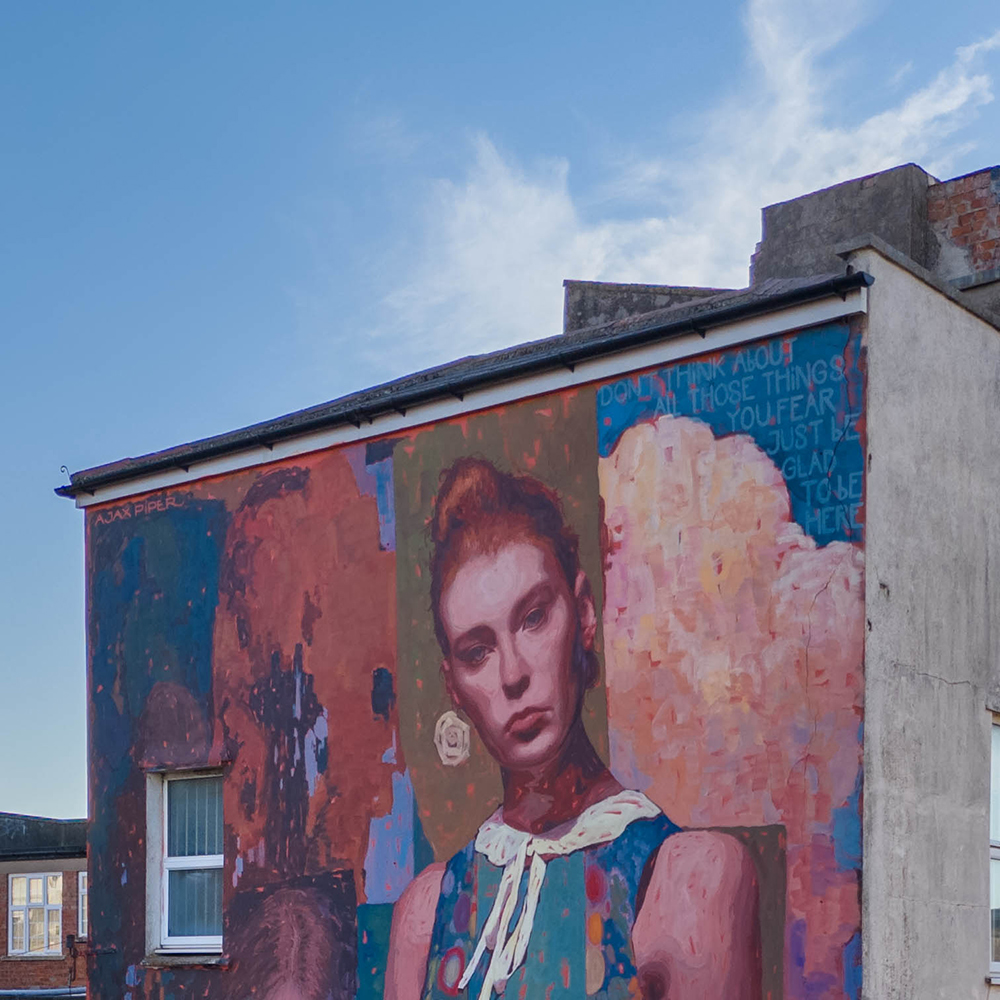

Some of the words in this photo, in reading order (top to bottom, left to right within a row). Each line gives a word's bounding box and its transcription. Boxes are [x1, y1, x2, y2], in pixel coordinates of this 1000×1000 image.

[687, 376, 756, 414] THOSE
[727, 402, 772, 433] YOU
[777, 388, 837, 425] FEAR
[767, 419, 823, 455] JUST
[782, 450, 837, 481] GLAD
[801, 479, 832, 507] TO
[94, 506, 132, 527] AJAX
[805, 502, 865, 536] HERE
